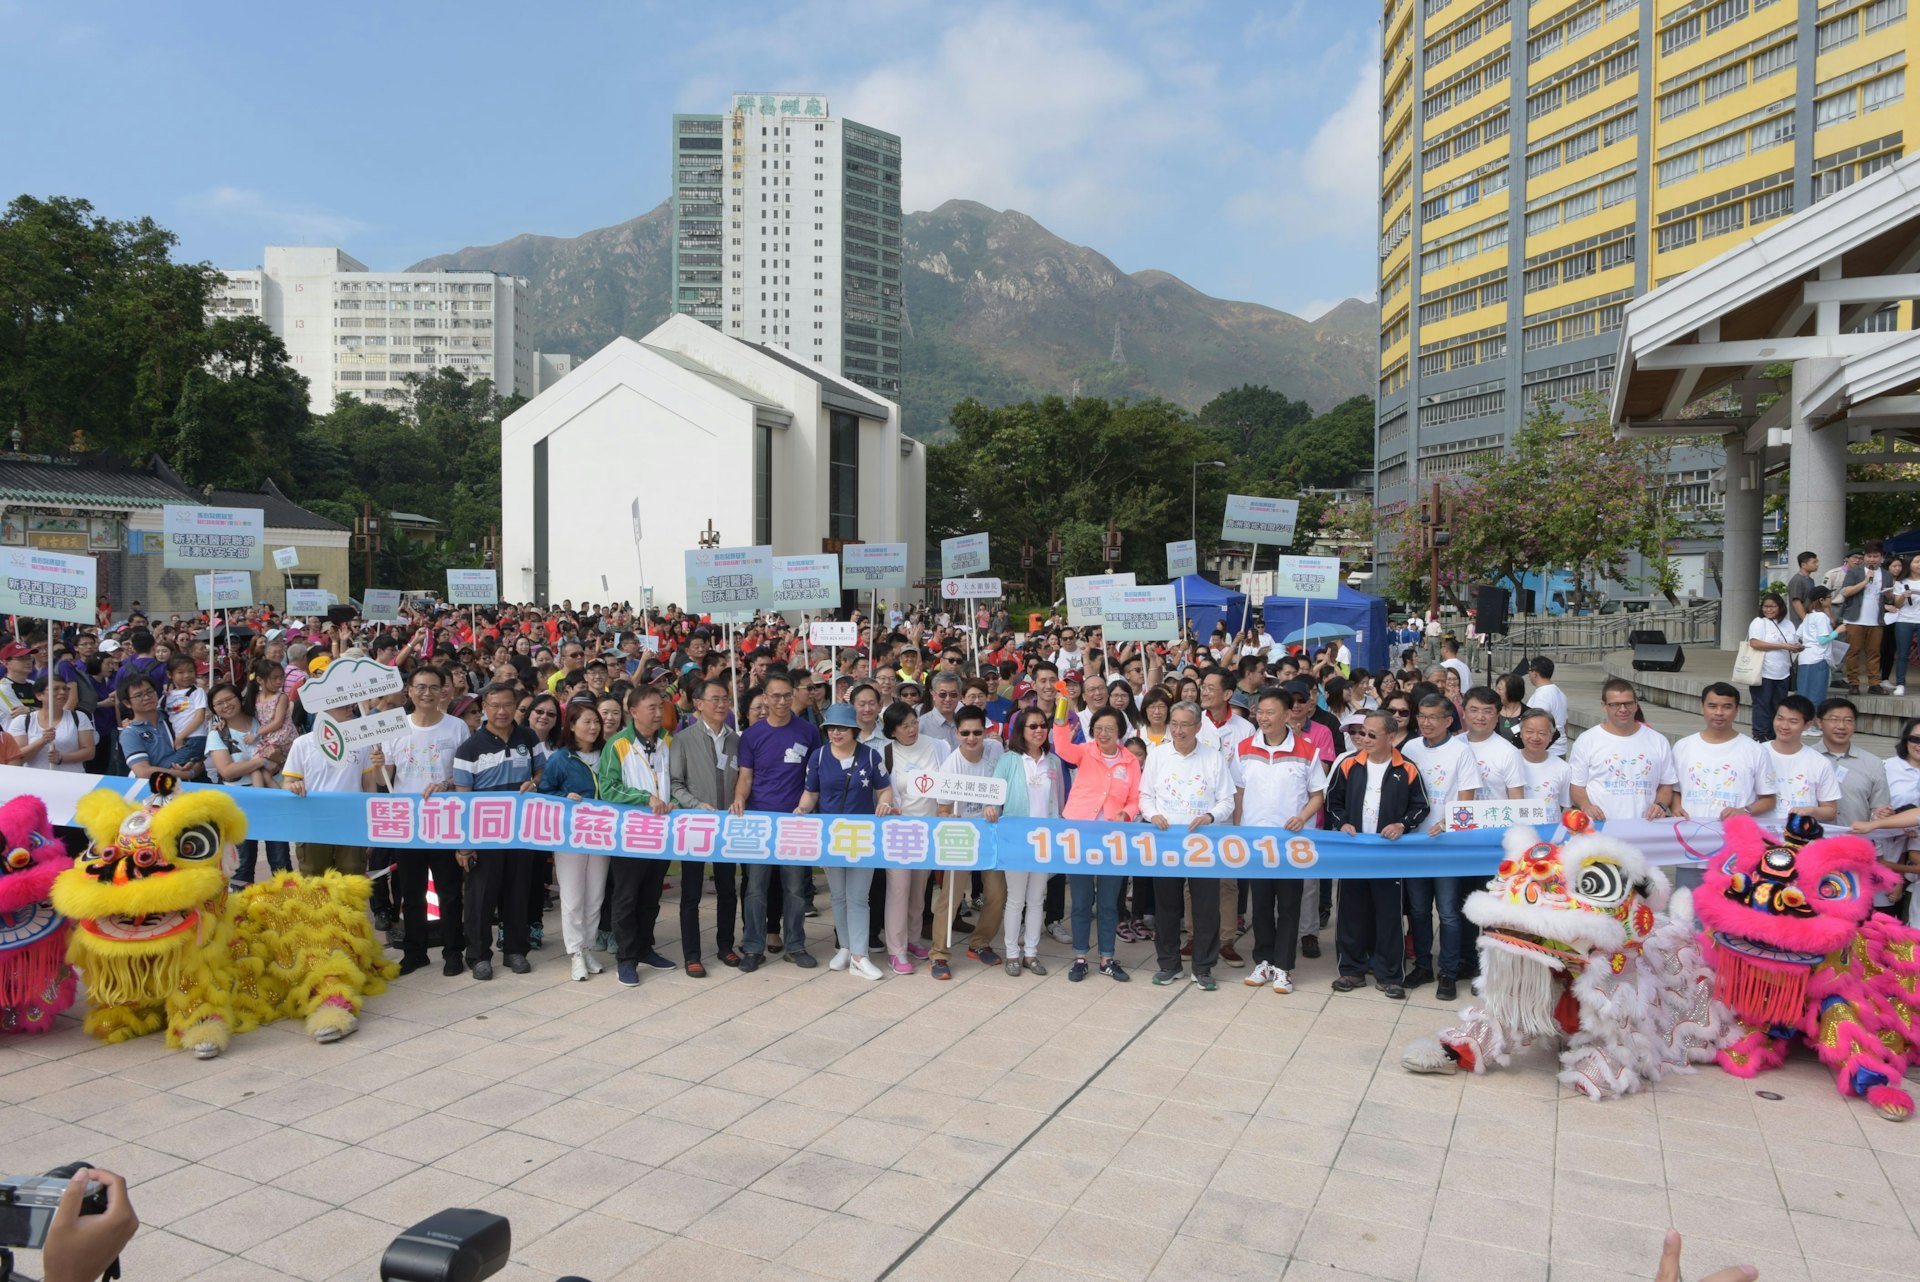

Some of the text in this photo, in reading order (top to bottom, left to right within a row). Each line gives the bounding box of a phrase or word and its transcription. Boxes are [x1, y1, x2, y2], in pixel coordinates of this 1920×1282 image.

[295, 283, 304, 292] 15
[295, 319, 305, 328] 13
[173, 533, 255, 547] 新界西醫院聯網
[179, 546, 250, 559] 質素及安全部
[8, 577, 88, 599] 新界西醫院聯網
[707, 574, 753, 589] 屯門醫院
[782, 578, 820, 589] 博愛醫院
[19, 592, 77, 610] 普通科門診
[702, 587, 759, 603] 臨床腫瘤科
[774, 588, 830, 601] 內科及老人科
[326, 682, 399, 705] Castle Peak Hospital
[344, 723, 407, 743] Siu Lam Hospital
[941, 779, 1000, 795] 天水圍醫院
[368, 799, 1317, 868] 醫社同心慈善行暨嘉年華會 11.11.2018
